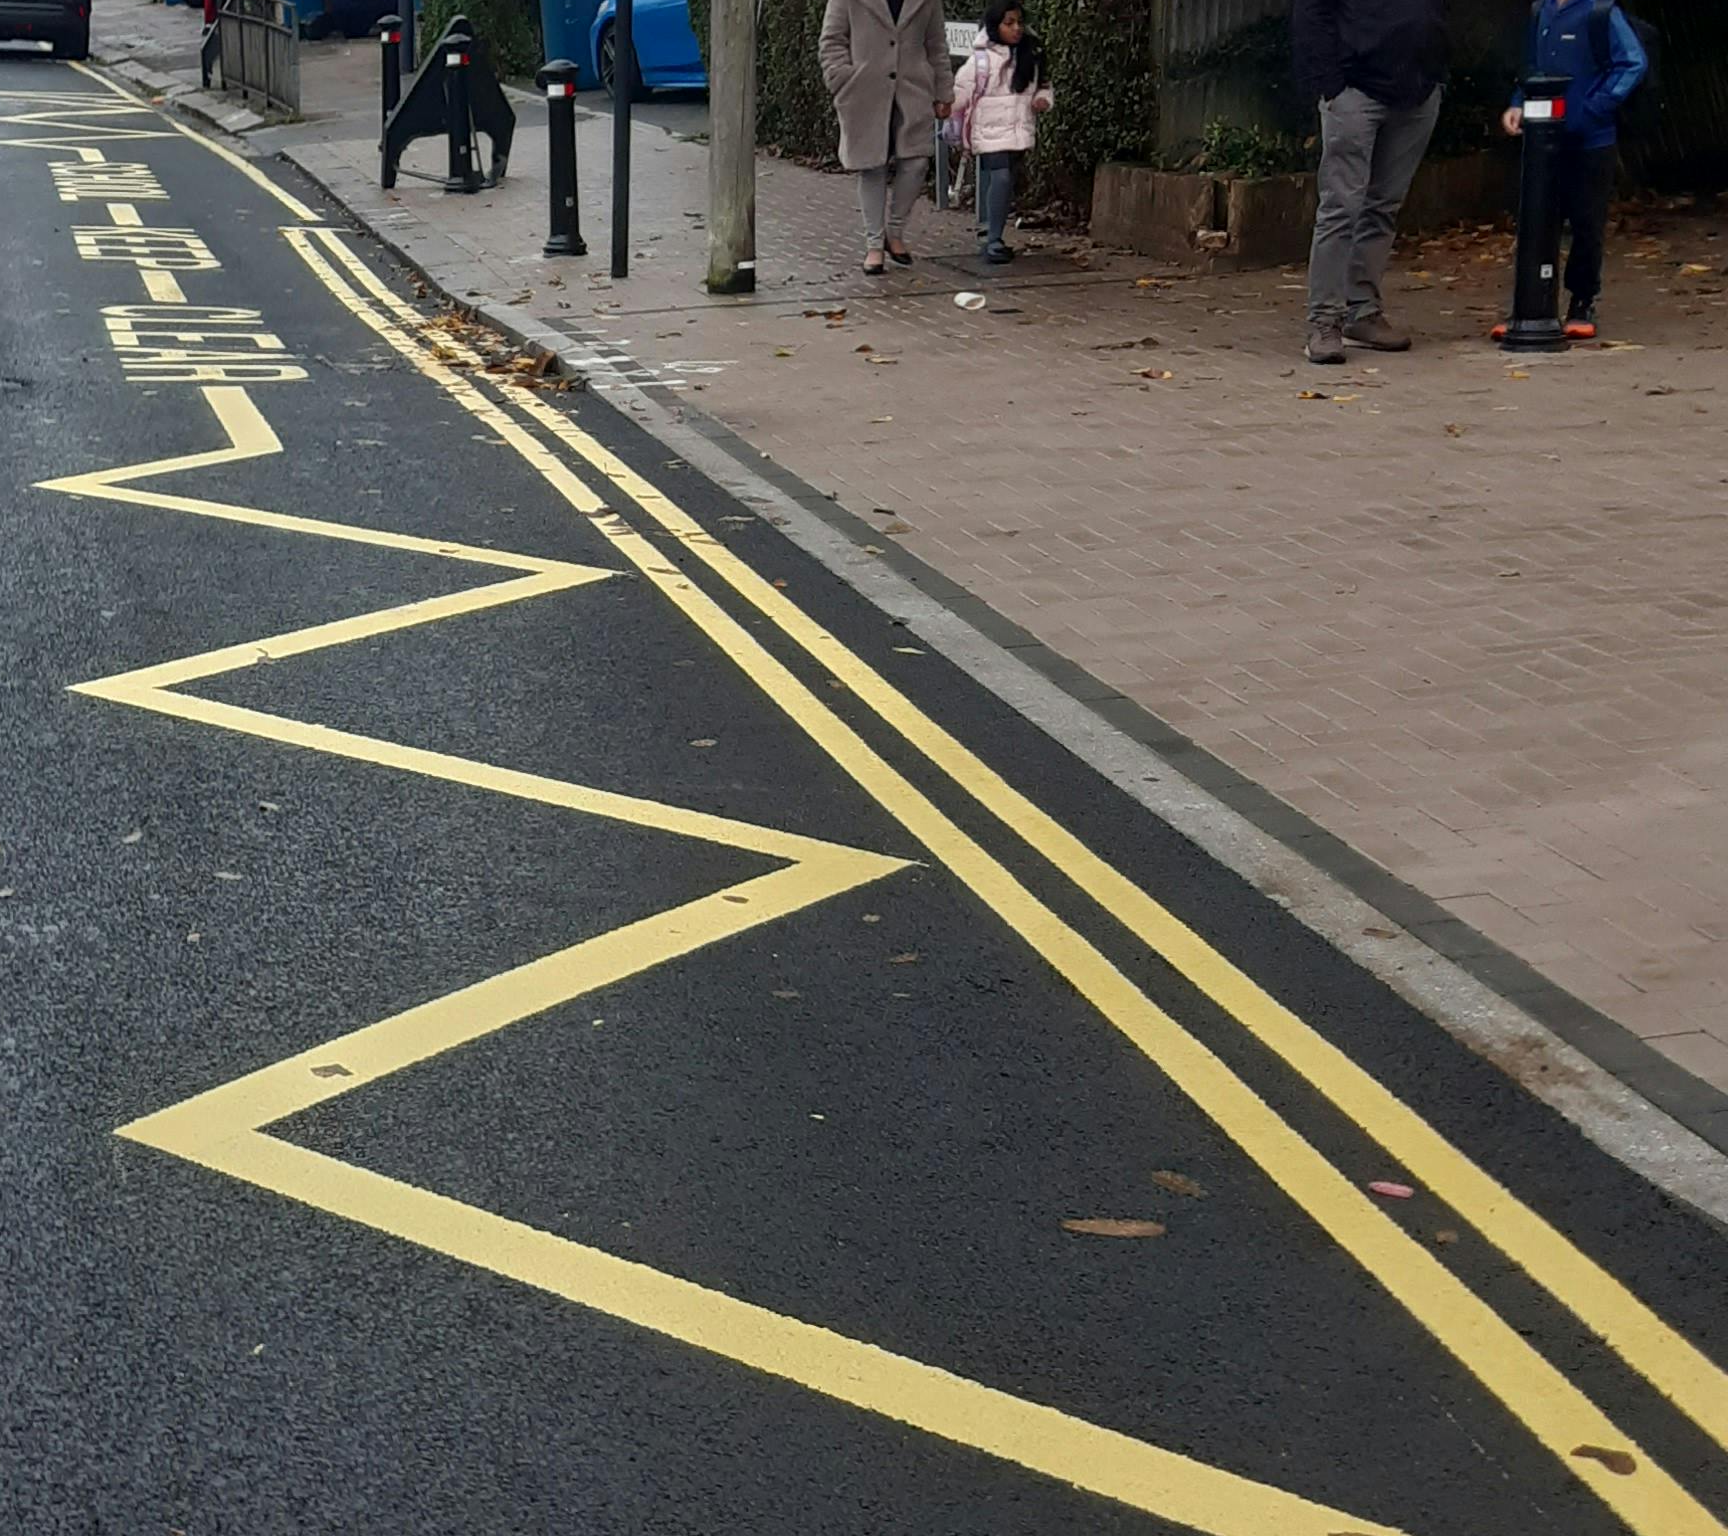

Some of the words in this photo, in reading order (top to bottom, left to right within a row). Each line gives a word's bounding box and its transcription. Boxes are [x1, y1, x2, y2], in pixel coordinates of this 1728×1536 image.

[47, 160, 172, 202] SCHOOL
[70, 225, 223, 271] KEEP
[98, 304, 311, 383] CLEAR
